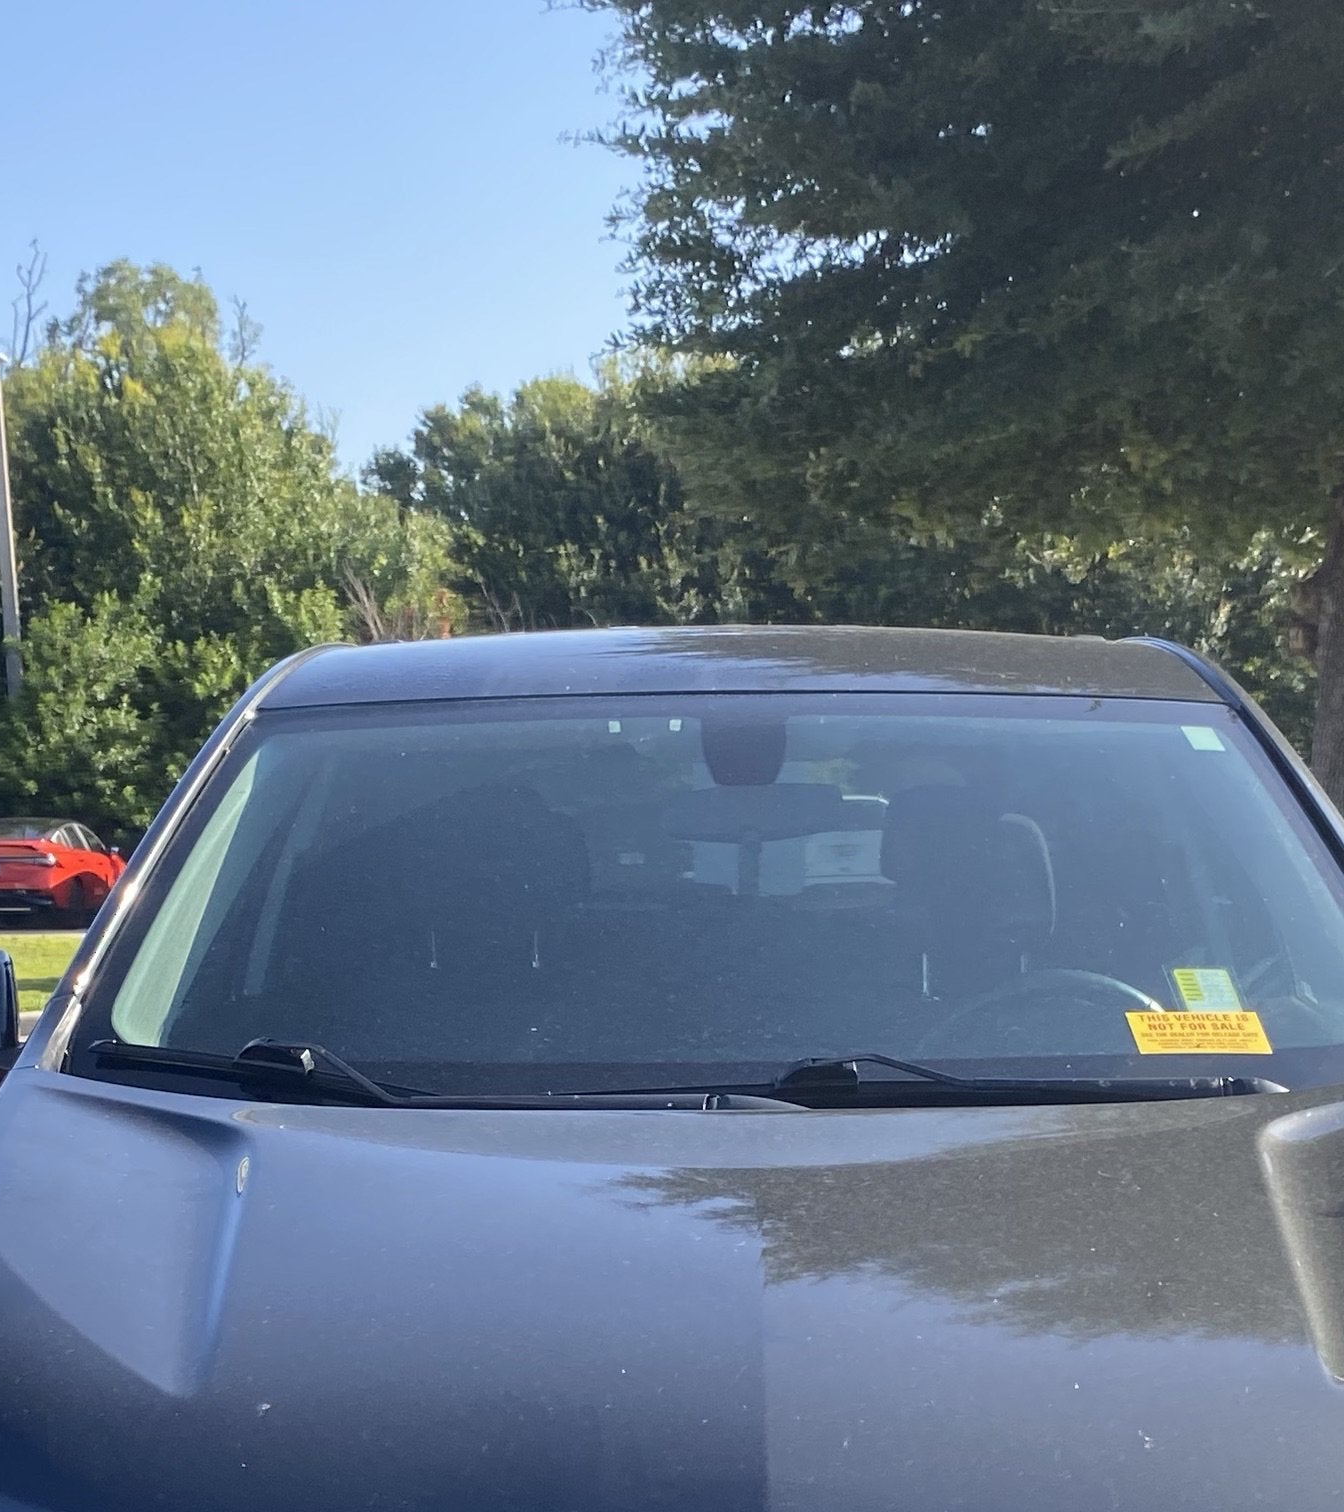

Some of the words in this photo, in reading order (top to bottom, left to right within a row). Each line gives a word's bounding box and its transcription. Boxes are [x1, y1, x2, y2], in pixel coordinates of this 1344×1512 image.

[1137, 1013, 1170, 1022] THIS
[1173, 1013, 1231, 1022] VEHICLE
[1235, 1013, 1249, 1022] IS
[1148, 1022, 1175, 1031] NOT
[1180, 1022, 1207, 1031] FOR
[1211, 1022, 1246, 1031] SALE
